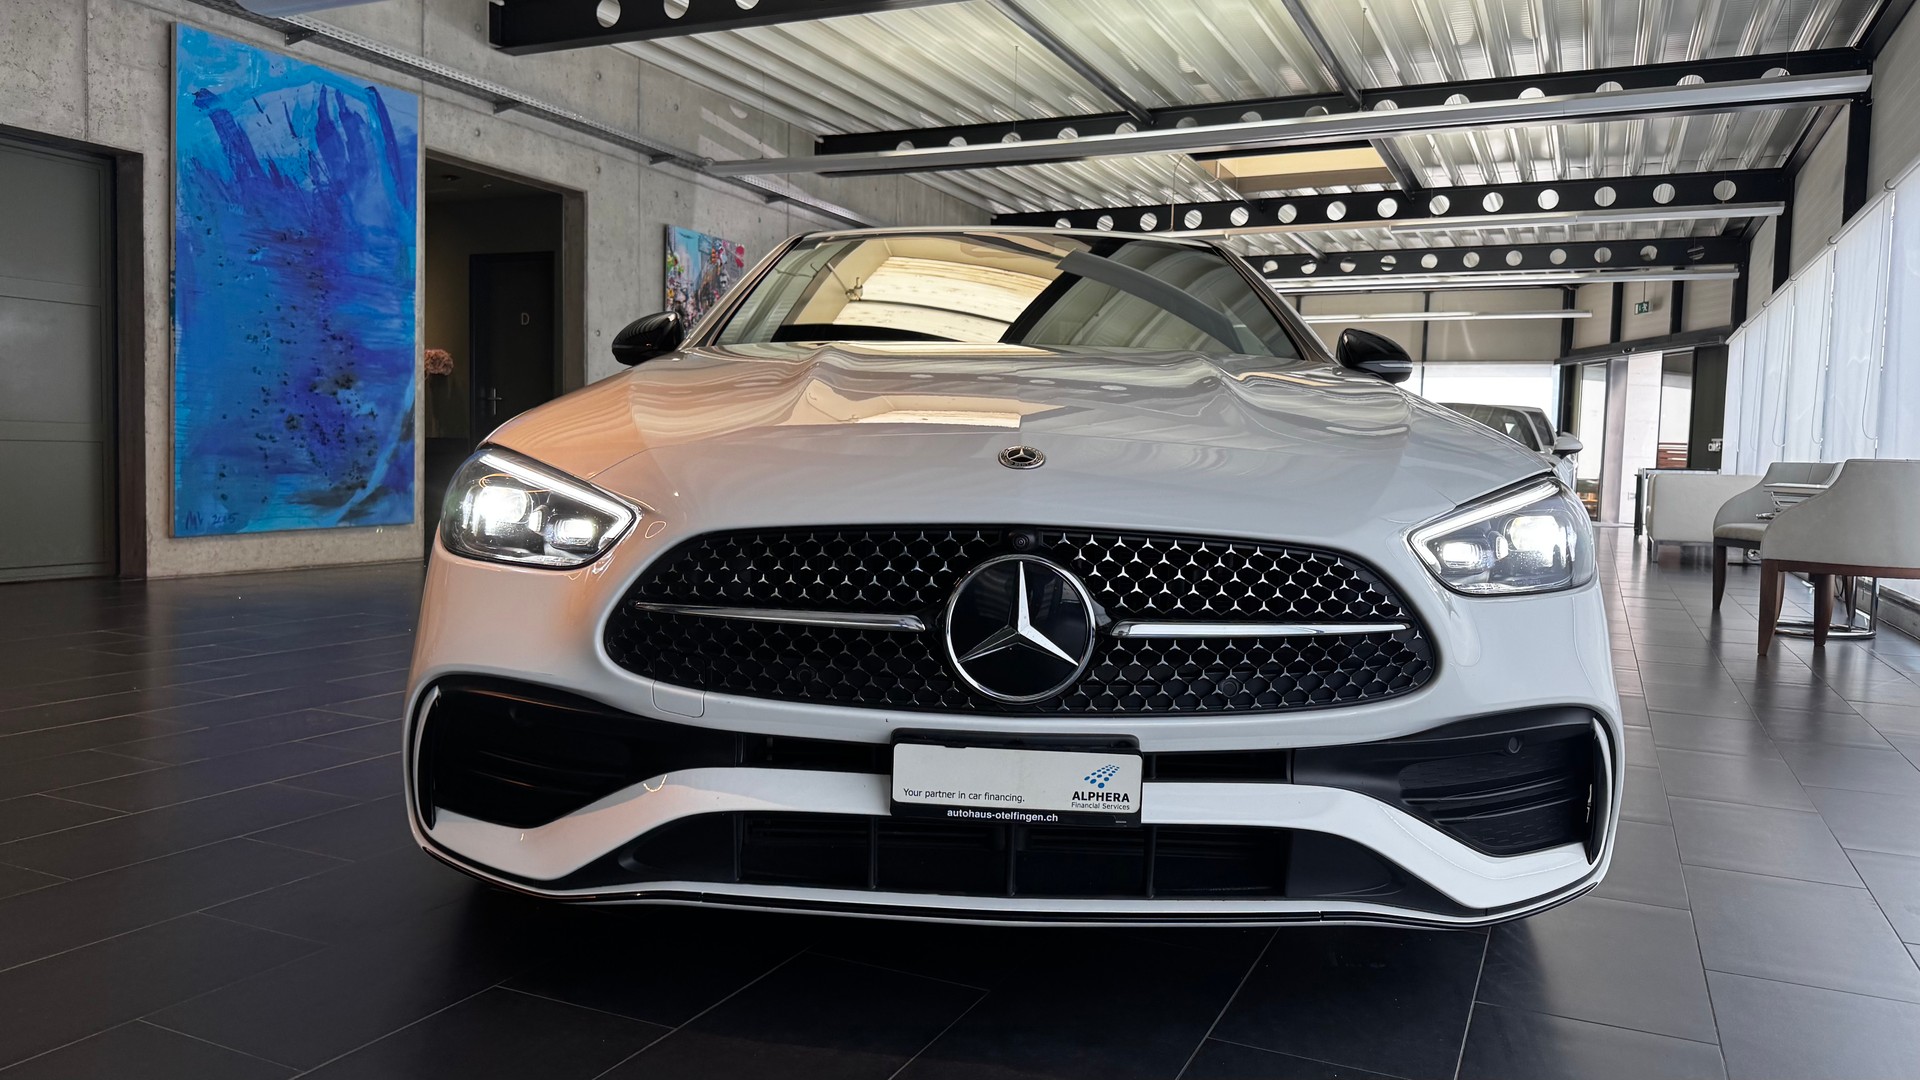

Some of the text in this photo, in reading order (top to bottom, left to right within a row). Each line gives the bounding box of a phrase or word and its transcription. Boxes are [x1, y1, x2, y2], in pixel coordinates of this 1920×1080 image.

[520, 312, 530, 325] D
[903, 788, 1025, 804] Your partner in car financing.
[1072, 791, 1130, 803] ALPHERA
[947, 809, 1058, 822] autohaus-otelfingen.ch
